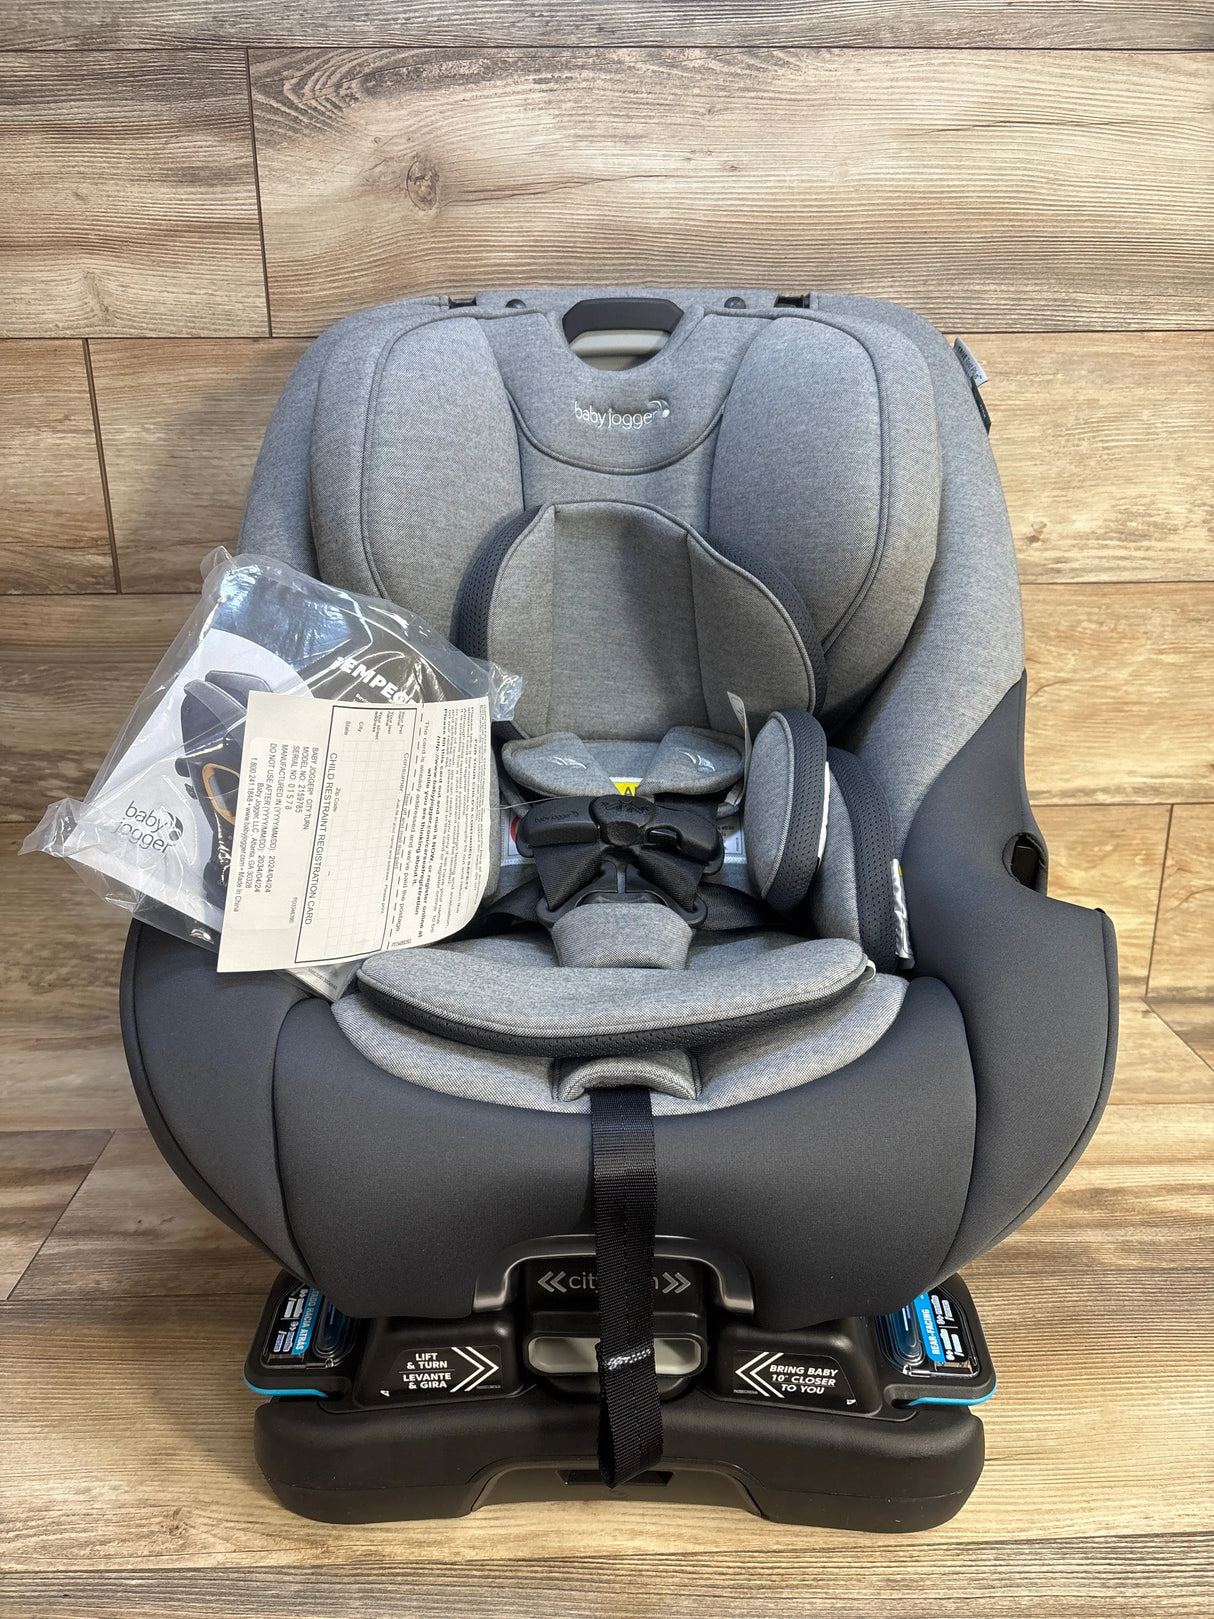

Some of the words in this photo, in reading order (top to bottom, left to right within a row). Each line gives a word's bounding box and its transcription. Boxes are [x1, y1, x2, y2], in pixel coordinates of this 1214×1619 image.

[574, 400, 606, 428] baby
[607, 408, 657, 430] jogger
[269, 743, 276, 753] DO
[290, 745, 299, 768] SERIAL
[300, 746, 309, 769] MODEL
[310, 747, 319, 764] BABY
[267, 754, 275, 767] NOT
[275, 744, 288, 797] MANUFACTURED
[326, 752, 337, 780] CHILD
[245, 757, 257, 801] 1.800.241.1848
[265, 769, 273, 782] USE
[416, 764, 424, 791] already
[255, 782, 263, 798] Baby
[263, 783, 272, 805] AFTER
[295, 784, 305, 813] 2159785
[125, 800, 168, 833] baby
[319, 782, 333, 832] RESTRAINT
[410, 793, 420, 832] addressed
[302, 813, 310, 829] TURN
[111, 817, 176, 853] jogger
[237, 806, 252, 866] www.babyjogger.com
[416, 821, 424, 853] thinking
[248, 860, 254, 869] GA
[254, 855, 264, 892] 2034/04/24
[264, 855, 275, 892] 2024/04/24
[308, 834, 325, 898] REGISTRATION
[245, 870, 253, 888] 30328
[233, 895, 241, 912] China
[304, 900, 314, 925] CARD
[302, 1307, 314, 1328] HACIA
[295, 1329, 308, 1350] ATRÁS
[921, 1309, 941, 1354] REAR-FACING
[406, 1361, 415, 1369] &
[417, 1360, 447, 1368] TURN
[415, 1352, 438, 1360] LIFT
[403, 1372, 451, 1381] LEVANTE
[769, 1364, 805, 1374] BRING
[807, 1367, 838, 1376] BABY
[791, 1375, 836, 1385] CLOSER
[408, 1381, 417, 1389] &
[420, 1380, 447, 1388] GIRA
[780, 1383, 796, 1391] TO
[800, 1385, 824, 1394] YOU
